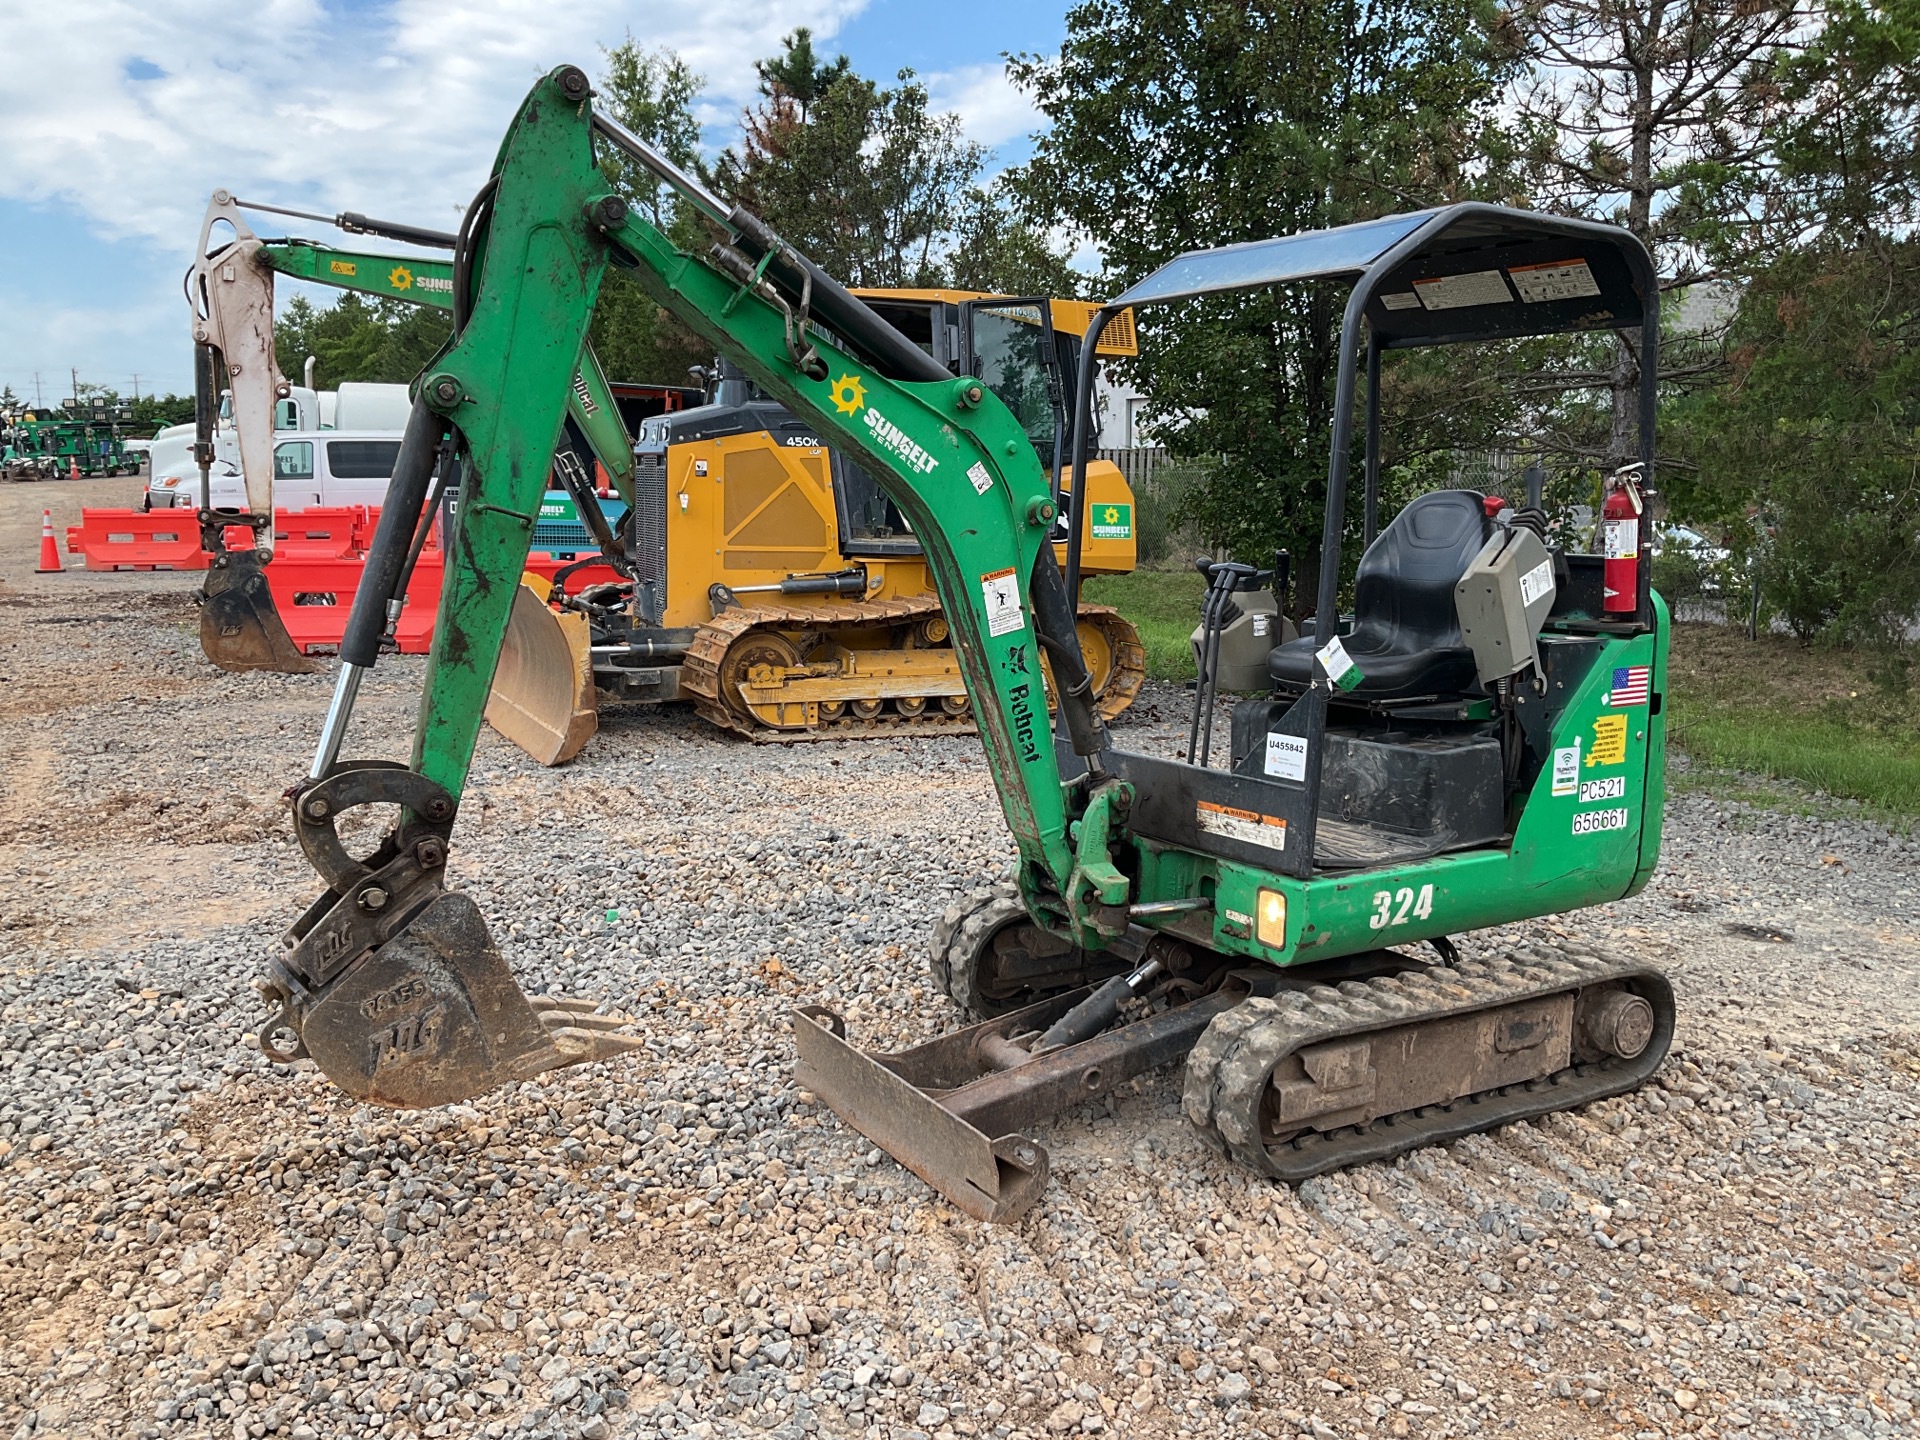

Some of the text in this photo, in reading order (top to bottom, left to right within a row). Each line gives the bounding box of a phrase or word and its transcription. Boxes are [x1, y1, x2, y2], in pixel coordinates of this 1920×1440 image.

[573, 366, 599, 415] obcat
[786, 436, 819, 447] 450K
[863, 407, 939, 474] SUNBELT
[868, 429, 921, 474] RENTALS
[1092, 525, 1130, 534] SUNBELT
[989, 568, 1014, 579] WARNING
[1009, 683, 1043, 763] Bobcat
[1269, 740, 1304, 754] U455842
[1580, 777, 1622, 801] PC521
[1230, 808, 1257, 820] WARNING
[1573, 809, 1625, 832] 656661
[1369, 883, 1434, 930] 324
